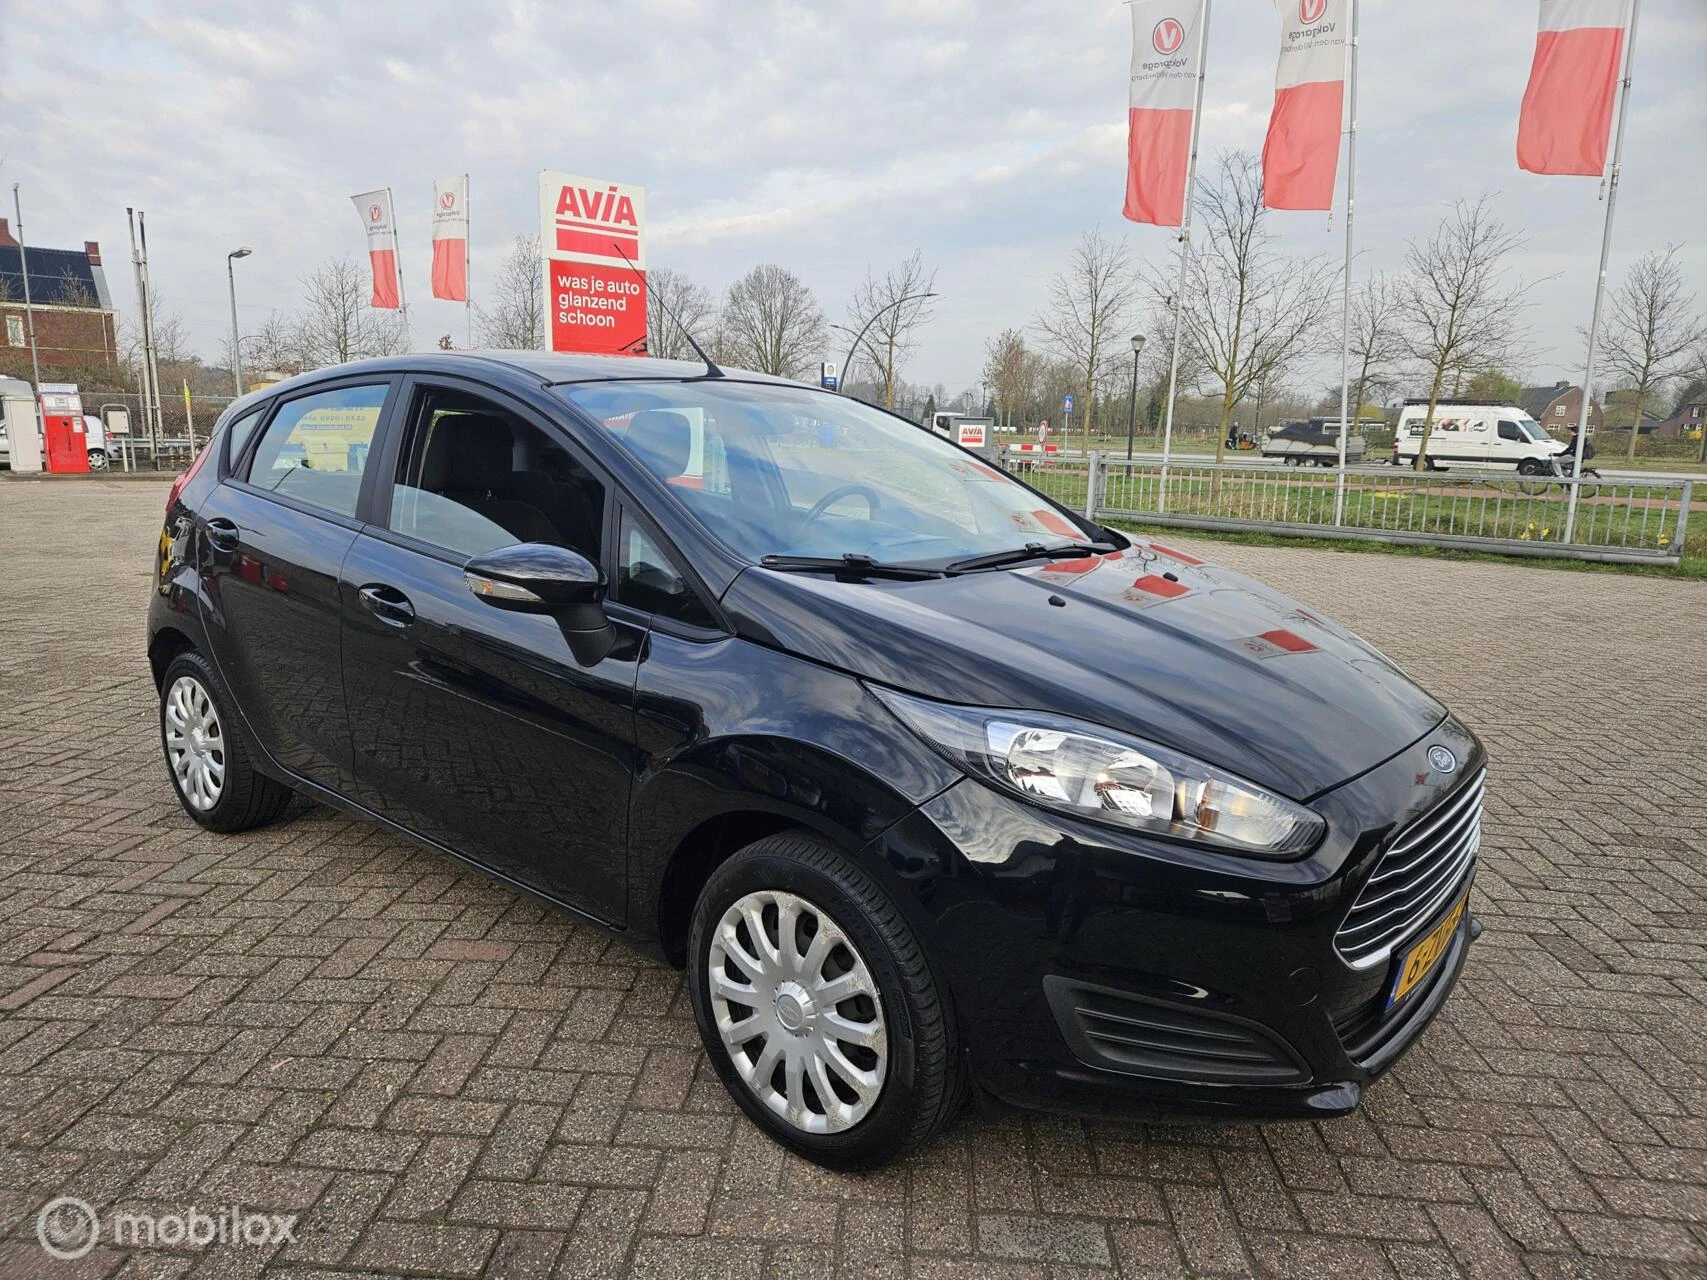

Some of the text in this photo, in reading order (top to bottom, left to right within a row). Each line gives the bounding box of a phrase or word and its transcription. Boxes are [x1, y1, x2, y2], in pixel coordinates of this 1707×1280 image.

[557, 275, 640, 295] was je auto
[558, 290, 627, 311] glanzend
[559, 310, 616, 328] schoon
